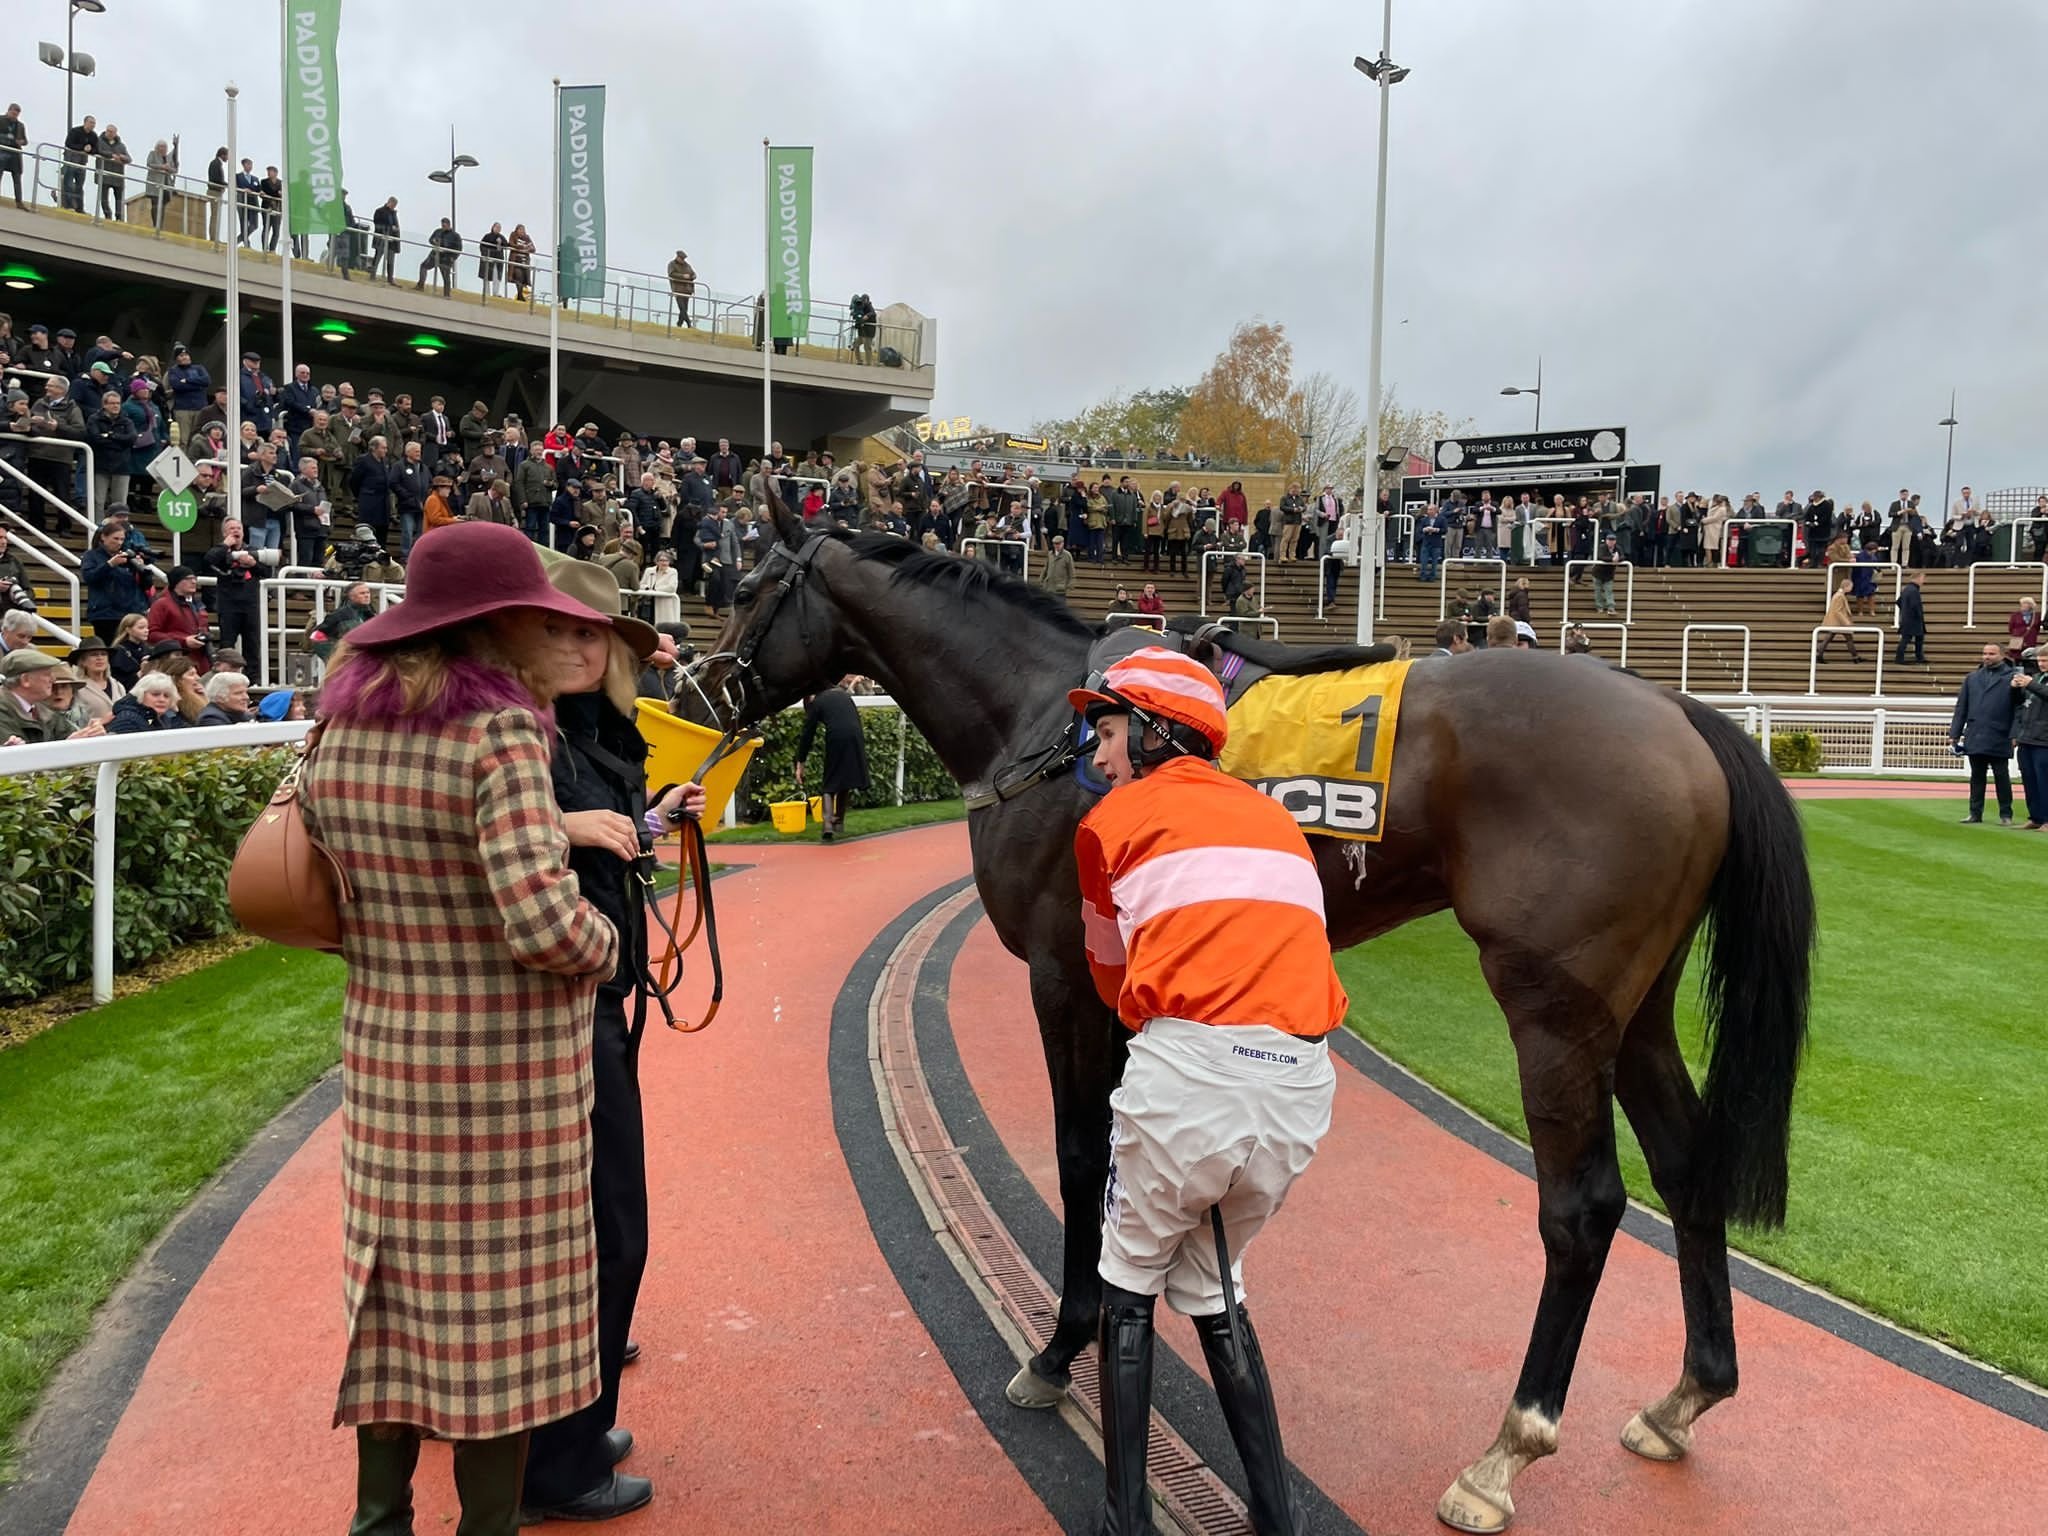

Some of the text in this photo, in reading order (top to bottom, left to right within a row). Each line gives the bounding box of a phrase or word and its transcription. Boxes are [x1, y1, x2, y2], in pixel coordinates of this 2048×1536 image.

[295, 11, 336, 206] PADDYPOWER
[568, 103, 598, 273] PADDYPOWER
[777, 163, 804, 315] PADDYPOWER
[916, 416, 971, 443] BAR
[1465, 437, 1589, 454] PRIME STEAK & CHICKEN
[172, 455, 181, 478] 1
[165, 500, 193, 518] 1ST
[1152, 720, 1171, 740] TKO
[1341, 694, 1384, 773] 1
[1232, 1045, 1298, 1065] FREEBETS.COM
